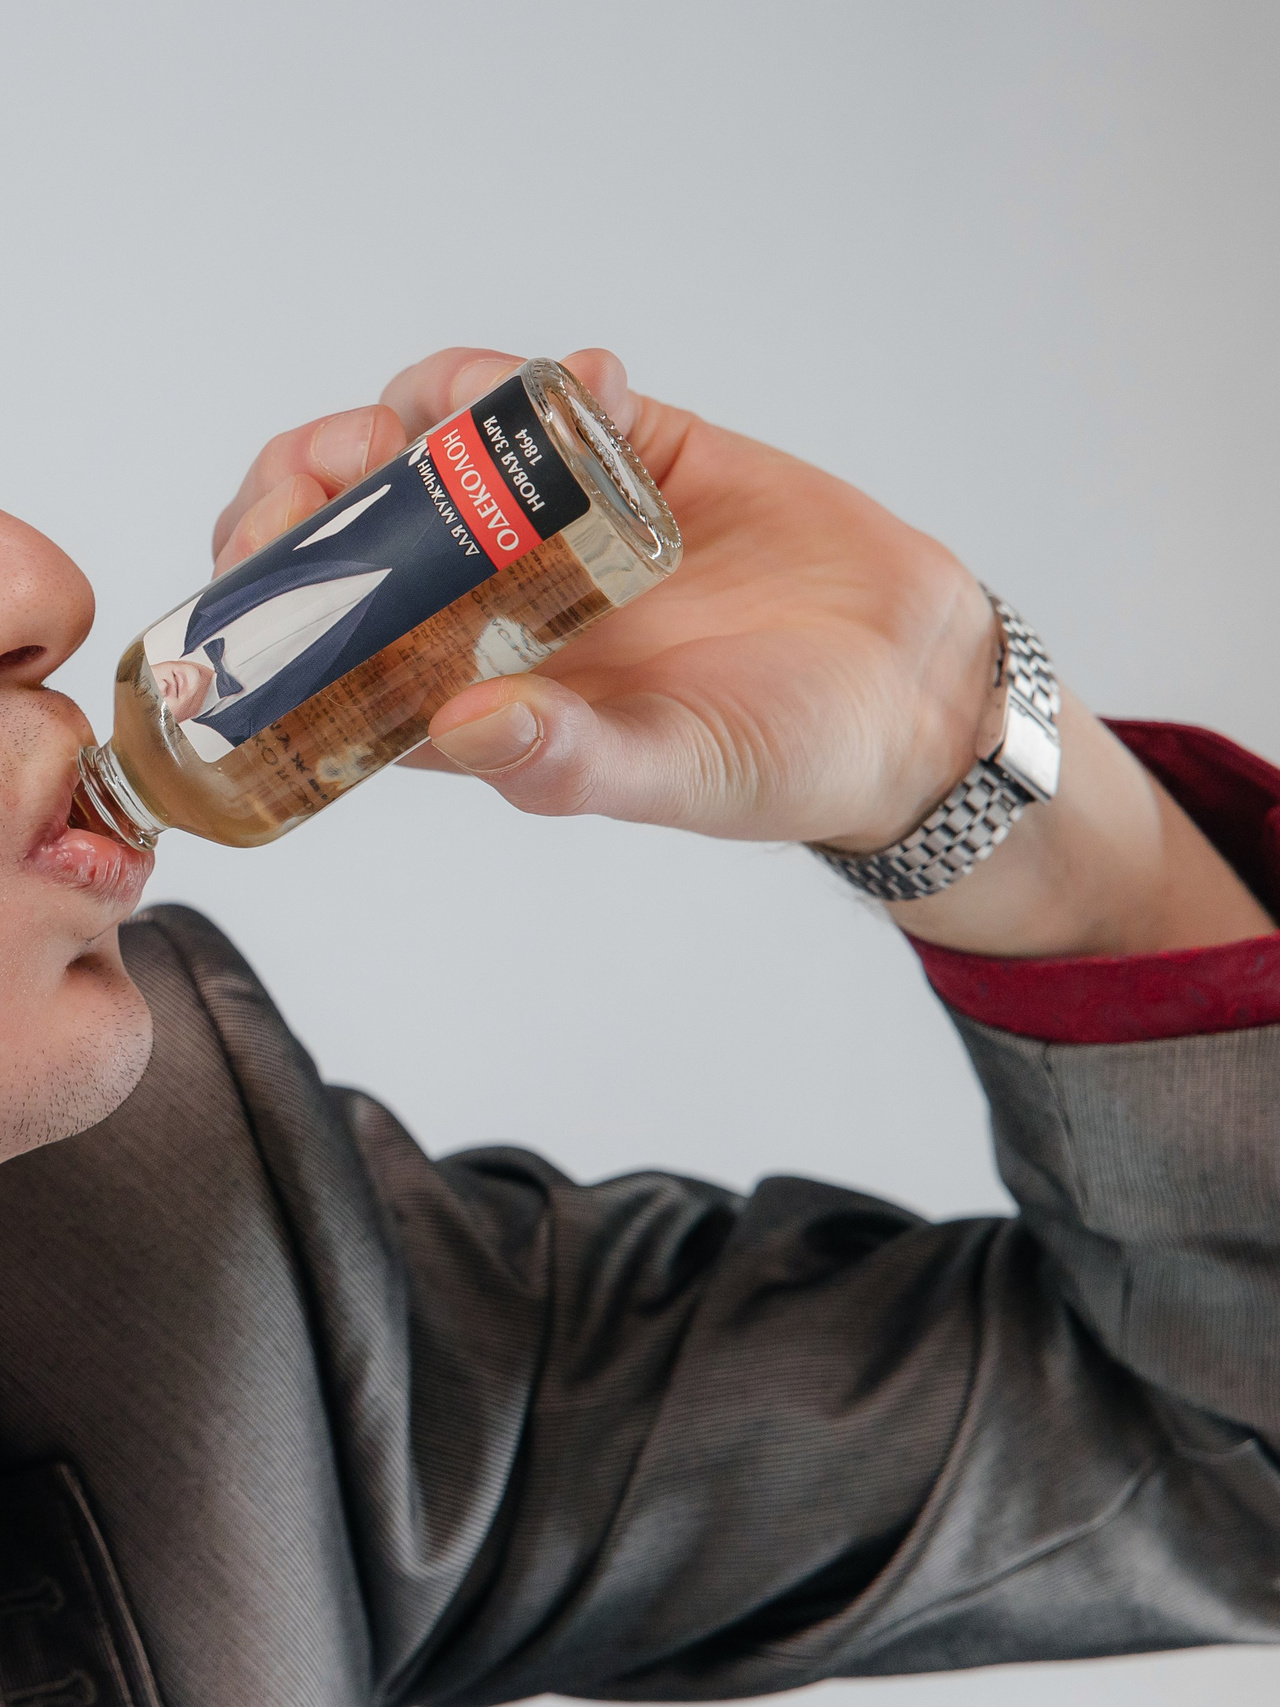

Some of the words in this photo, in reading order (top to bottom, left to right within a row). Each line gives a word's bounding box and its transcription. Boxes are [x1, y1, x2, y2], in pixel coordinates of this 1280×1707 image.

[483, 415, 509, 452] ЗАРЯ
[514, 428, 543, 466] 1864
[417, 459, 458, 524] МУЖЧИН
[441, 428, 520, 551] ОДЕКОЛОН
[501, 453, 545, 512] НОВАЯ
[450, 522, 480, 557] ДЛЯ
